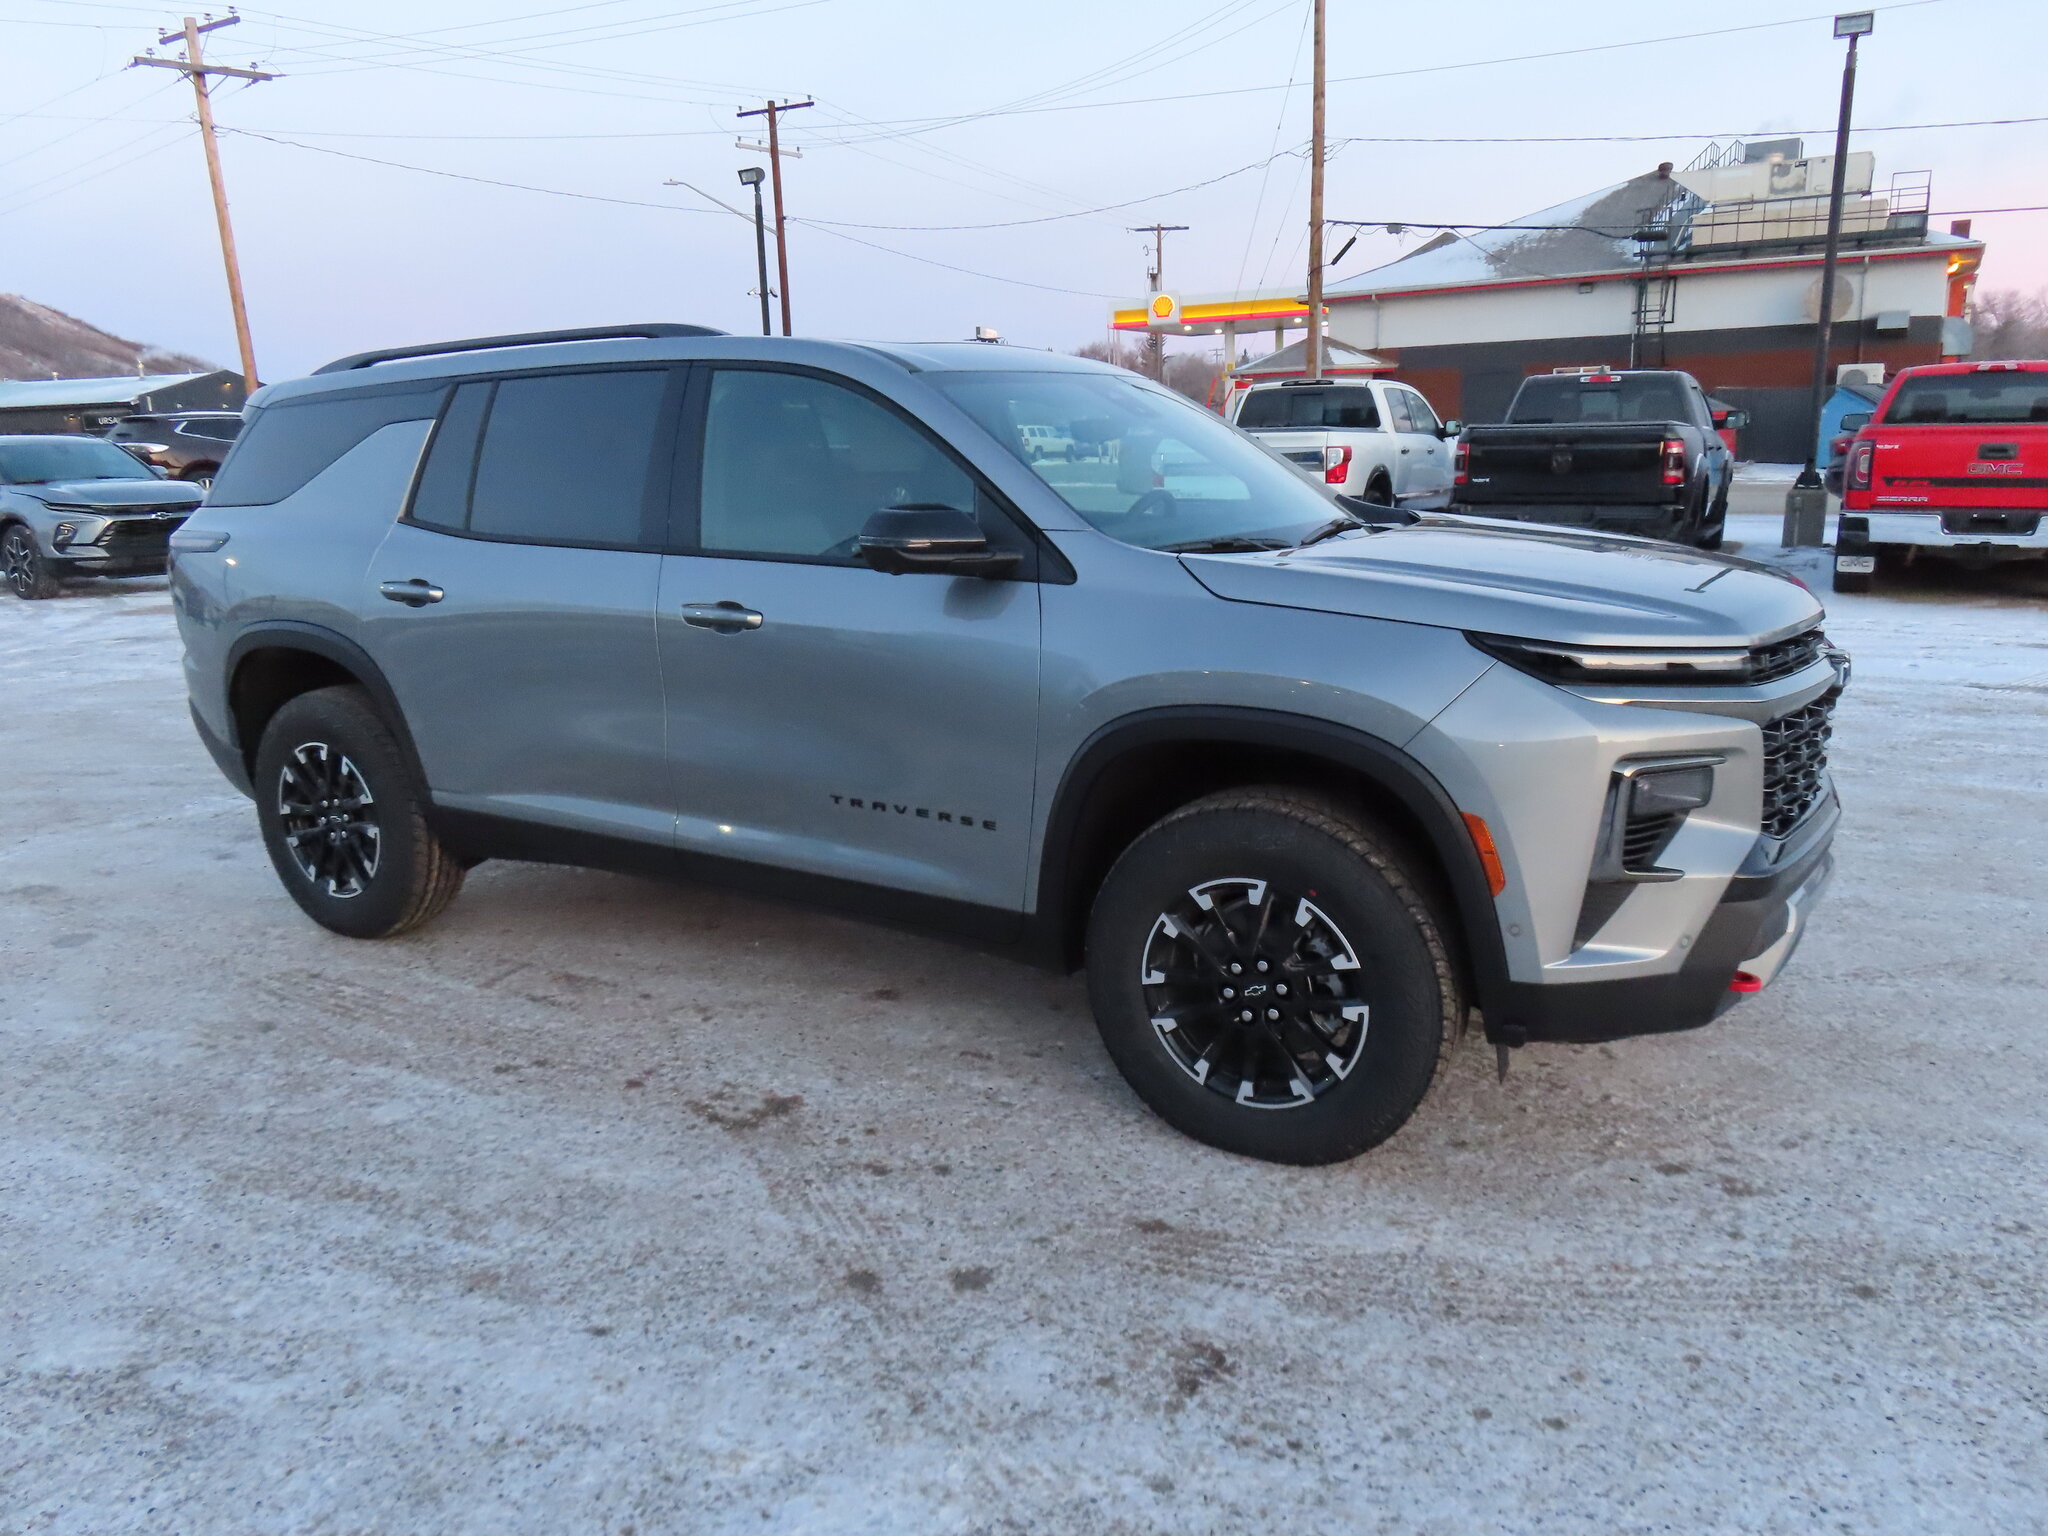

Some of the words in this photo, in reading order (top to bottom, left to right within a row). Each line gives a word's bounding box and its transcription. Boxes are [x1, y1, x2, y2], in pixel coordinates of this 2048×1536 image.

[1968, 463, 2024, 475] GMC
[1840, 560, 1870, 568] GMC
[829, 794, 997, 831] TRAVERSE
